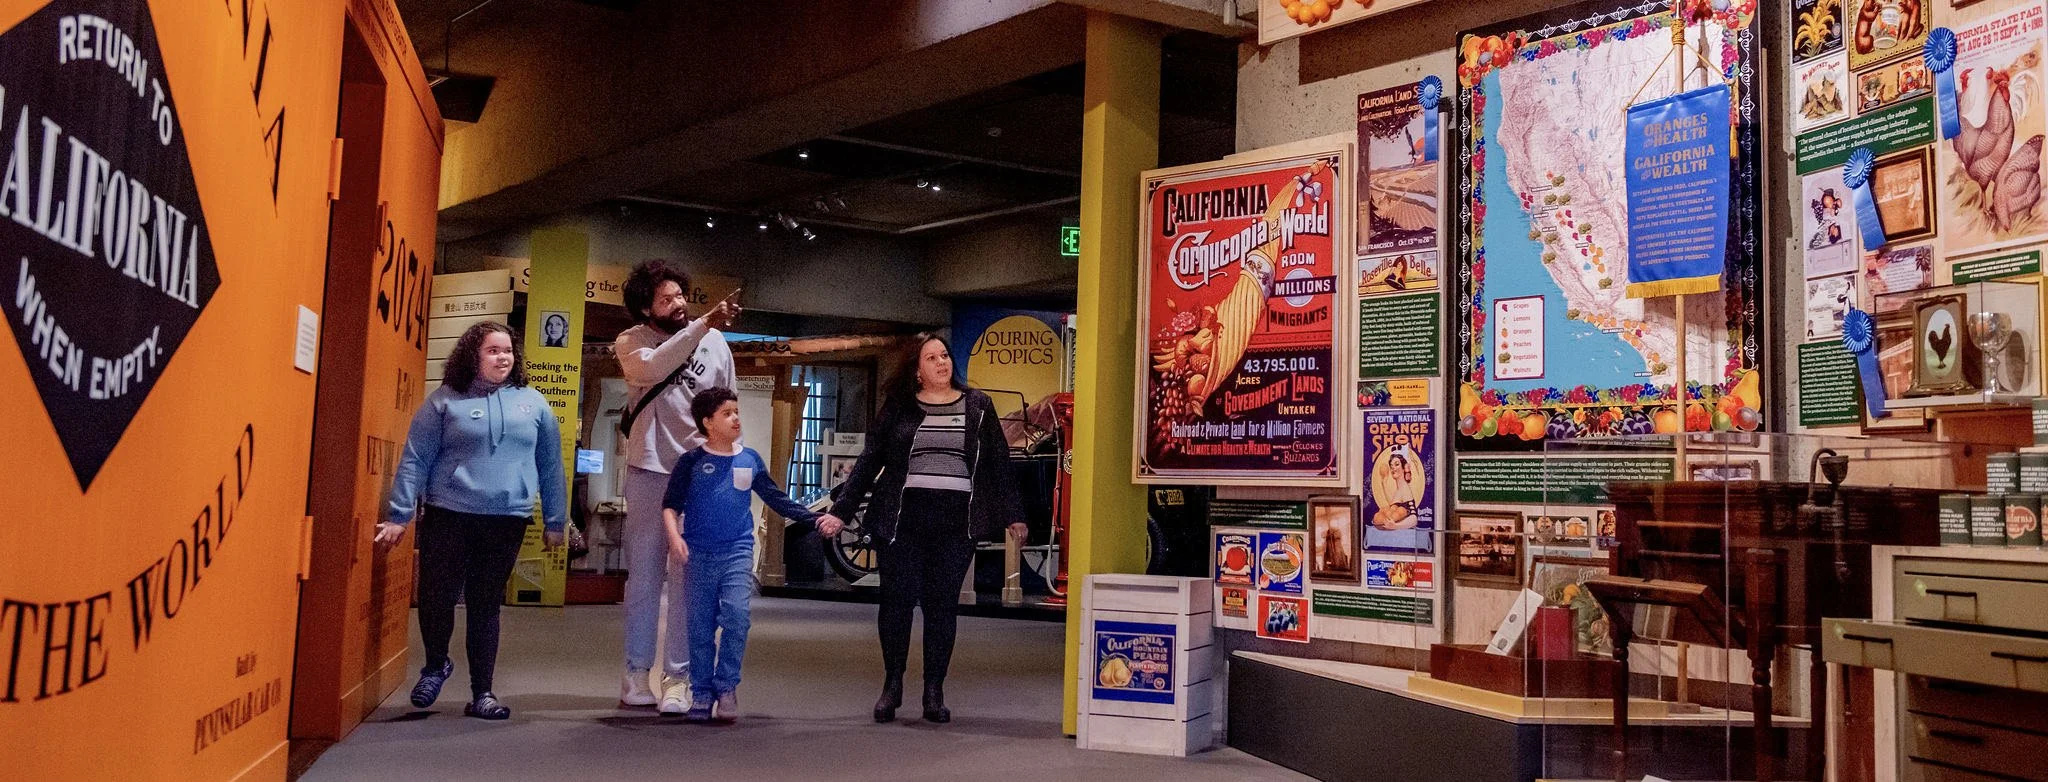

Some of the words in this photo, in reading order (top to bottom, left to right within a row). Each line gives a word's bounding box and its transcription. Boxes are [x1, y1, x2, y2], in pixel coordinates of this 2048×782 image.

[1991, 14, 2018, 30] STATE
[2020, 6, 2042, 21] FAIR
[1967, 37, 1981, 51] AUG
[2022, 22, 2027, 33] 4
[59, 14, 148, 97] RETURN
[152, 78, 173, 146] TO
[1360, 94, 1394, 110] CALIFORNIA
[1644, 113, 1708, 136] ORANGES
[1654, 126, 1707, 147] HEALTH
[1634, 144, 1715, 170] CALIFORNIA
[1652, 159, 1707, 179] WEALTH
[0, 85, 199, 309] ALIFORNIA
[1163, 184, 1269, 237] CALIFORNIA
[1168, 219, 1269, 290] Cornucopia
[1280, 200, 1329, 251] World
[1368, 242, 1394, 250] FRANCISCO
[1282, 253, 1315, 268] ROOM
[1362, 258, 1392, 284] Roseville
[1410, 255, 1431, 277] Belle
[599, 280, 619, 293] the
[1275, 279, 1331, 295] MILLIONS
[15, 256, 84, 392] WHEN
[88, 325, 163, 400] EMPTY.
[1266, 306, 1328, 332] IMMIGRANTS
[969, 329, 1053, 356] TOURING
[985, 348, 1053, 365] TOPICS
[526, 361, 561, 373] Seeking
[564, 362, 579, 372] the
[551, 373, 567, 383] Life
[1235, 373, 1260, 389] ACRES
[535, 385, 576, 396] Southern
[1225, 378, 1288, 415] GOVERNMENT
[1292, 372, 1324, 401] LANDS
[1278, 403, 1315, 415] UNTAKEN
[1366, 415, 1394, 423] SEVENTH
[1397, 414, 1431, 423] NATIONAL
[1172, 420, 1200, 437] Railroad
[1205, 421, 1229, 439] Private
[1231, 420, 1245, 439] Land
[1261, 423, 1265, 436] a
[1267, 420, 1291, 438] Million
[1293, 420, 1325, 438] Farmers
[1369, 423, 1428, 434] ORANGE
[1293, 441, 1324, 452] CYCLONES
[1372, 434, 1425, 463] SHOW
[0, 595, 112, 702] THE
[127, 424, 254, 653] WORLD
[1107, 635, 1165, 651] CALIFORNIA
[1133, 652, 1167, 661] PEARS
